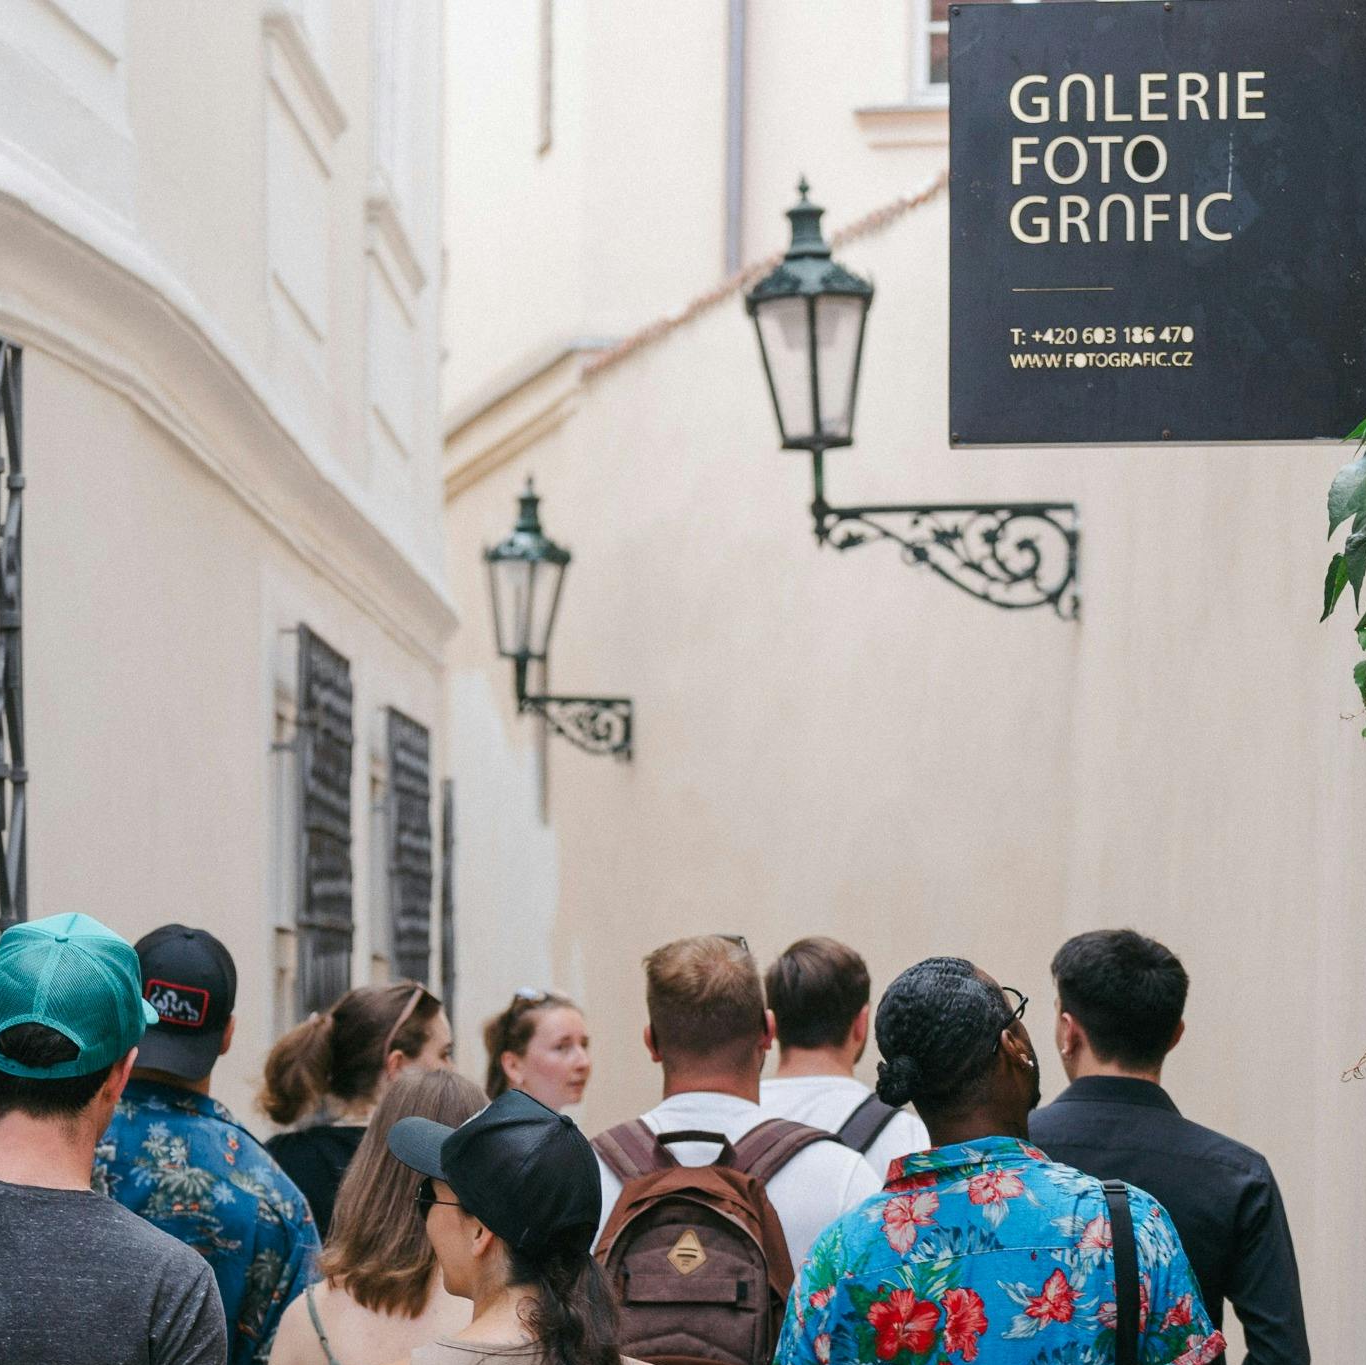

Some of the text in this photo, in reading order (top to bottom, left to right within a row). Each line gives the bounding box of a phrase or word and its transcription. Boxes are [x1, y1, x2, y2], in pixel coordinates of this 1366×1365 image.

[1009, 71, 1266, 124] GALERIE
[1011, 134, 1168, 186] FOTO
[1009, 192, 1233, 245] GRAFIC
[1009, 325, 1195, 346] T: +420 603 186 470
